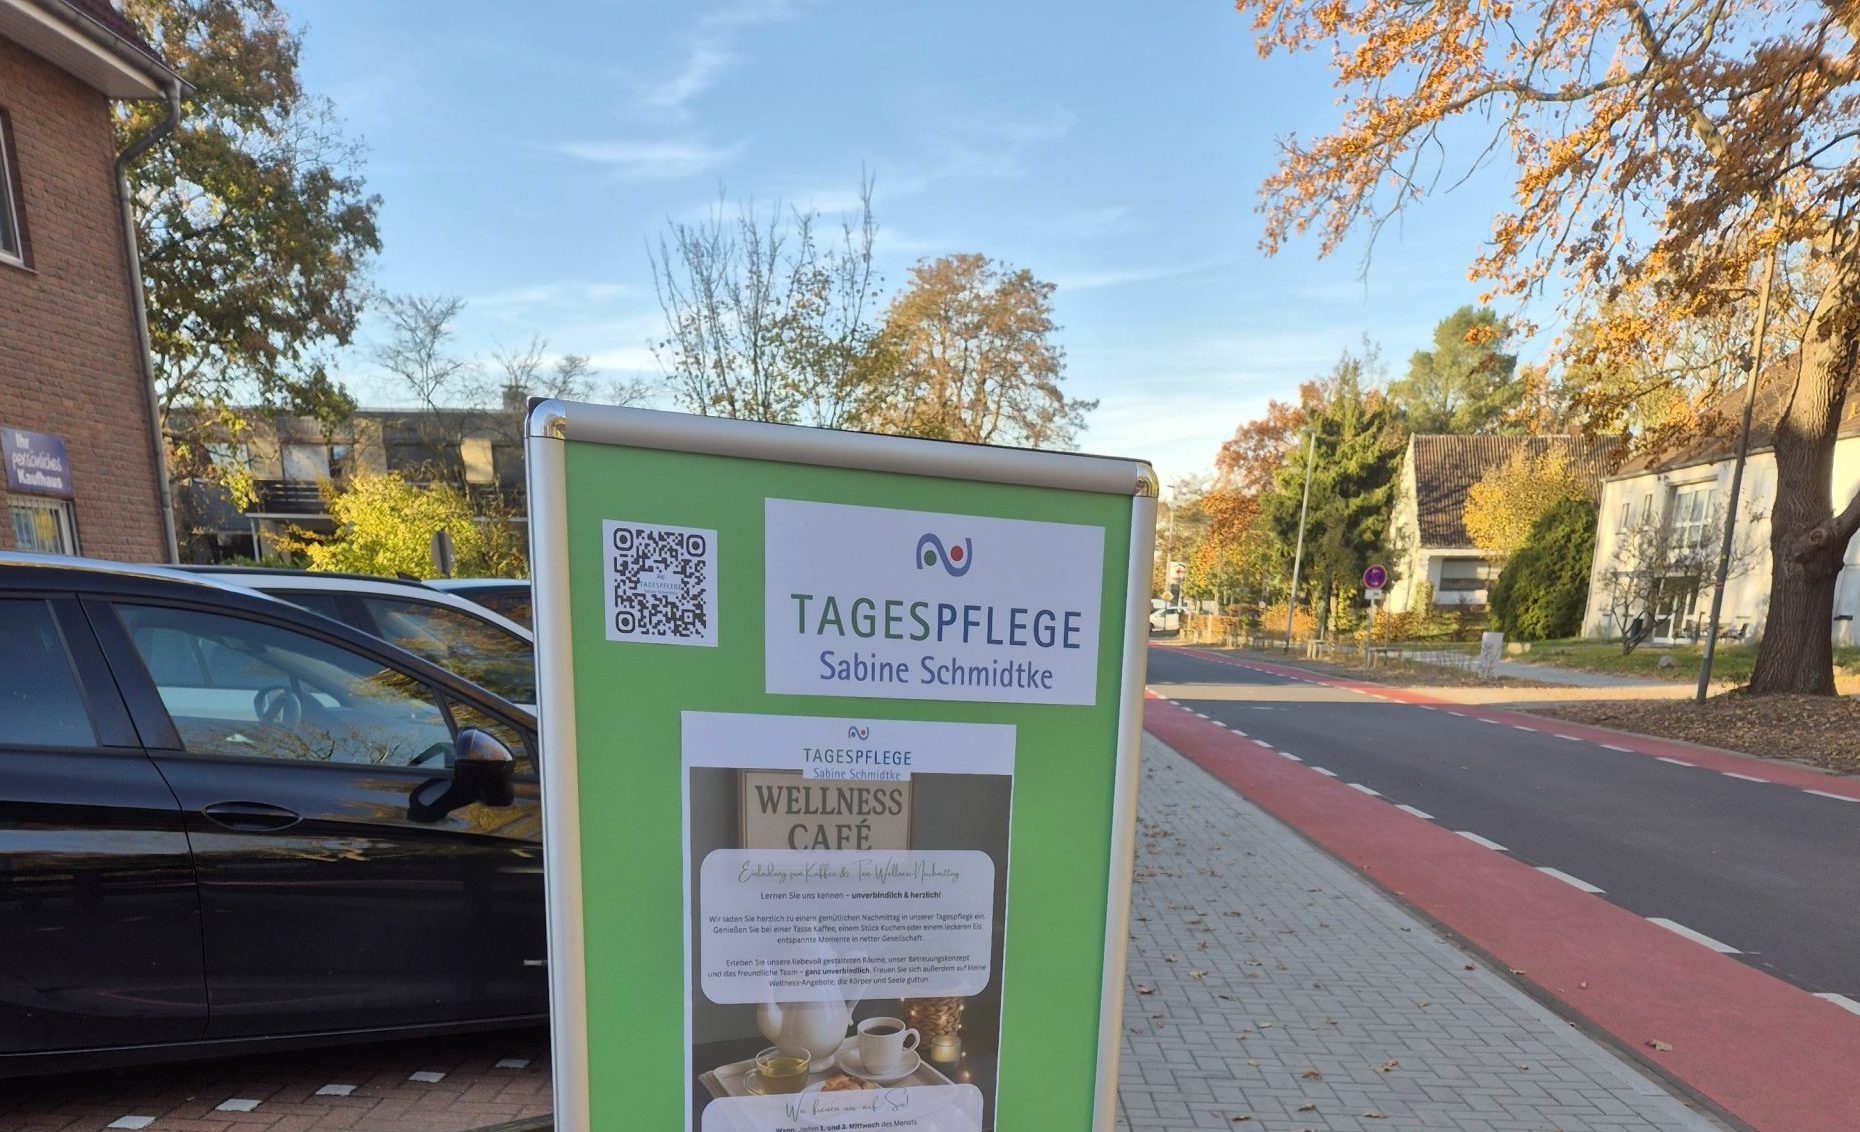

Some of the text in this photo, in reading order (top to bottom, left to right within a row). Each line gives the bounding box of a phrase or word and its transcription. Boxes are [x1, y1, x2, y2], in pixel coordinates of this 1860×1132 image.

[16, 468, 63, 489] Kaufhaus
[790, 593, 1082, 649] TAGESPFLEGE
[820, 650, 1053, 689] Sabine Schmidtke
[803, 748, 912, 766] TAGESPFLEGE
[813, 767, 901, 781] Sabine Schmidtke
[755, 785, 903, 816] WELLNESS
[787, 819, 872, 850] CAFÉ
[760, 892, 788, 900] Lernen
[788, 892, 800, 900] Sie
[817, 892, 844, 900] kennen
[851, 891, 903, 899] unverbindlich
[910, 891, 942, 899] herzlich!
[722, 915, 743, 923] laden
[756, 914, 785, 922] herzlich
[795, 914, 817, 922] einem
[818, 914, 861, 924] gemütlichen
[861, 913, 900, 922] Nachmittag
[901, 913, 908, 921] in
[908, 913, 935, 921] unserer
[935, 912, 974, 922] Tagespflege
[713, 926, 748, 934] Genießen
[748, 925, 760, 933] Sie
[761, 925, 772, 933] bei
[860, 924, 879, 932] Stück
[906, 922, 921, 931] oder
[923, 923, 944, 931] einem
[944, 922, 972, 930] leckeren
[777, 937, 817, 945] entspannte
[852, 935, 859, 943] in
[859, 935, 881, 943] netter
[726, 959, 753, 967] Erleben
[792, 957, 822, 965] liebevoll
[822, 957, 861, 966] gestalteten
[908, 955, 970, 963] Betreuungskonzept
[707, 970, 722, 978] und
[737, 968, 778, 977] freundliche
[805, 969, 822, 977] ganz
[872, 966, 897, 974] Freuen
[896, 965, 908, 973] Sie
[908, 965, 922, 973] sich
[837, 978, 848, 986] die
[887, 976, 906, 984] Seele
[798, 1125, 819, 1132] Jeden
[827, 1124, 841, 1132] und
[849, 1121, 880, 1130] Mittwoch
[881, 1121, 893, 1129] des
[893, 1120, 918, 1128] Monats
